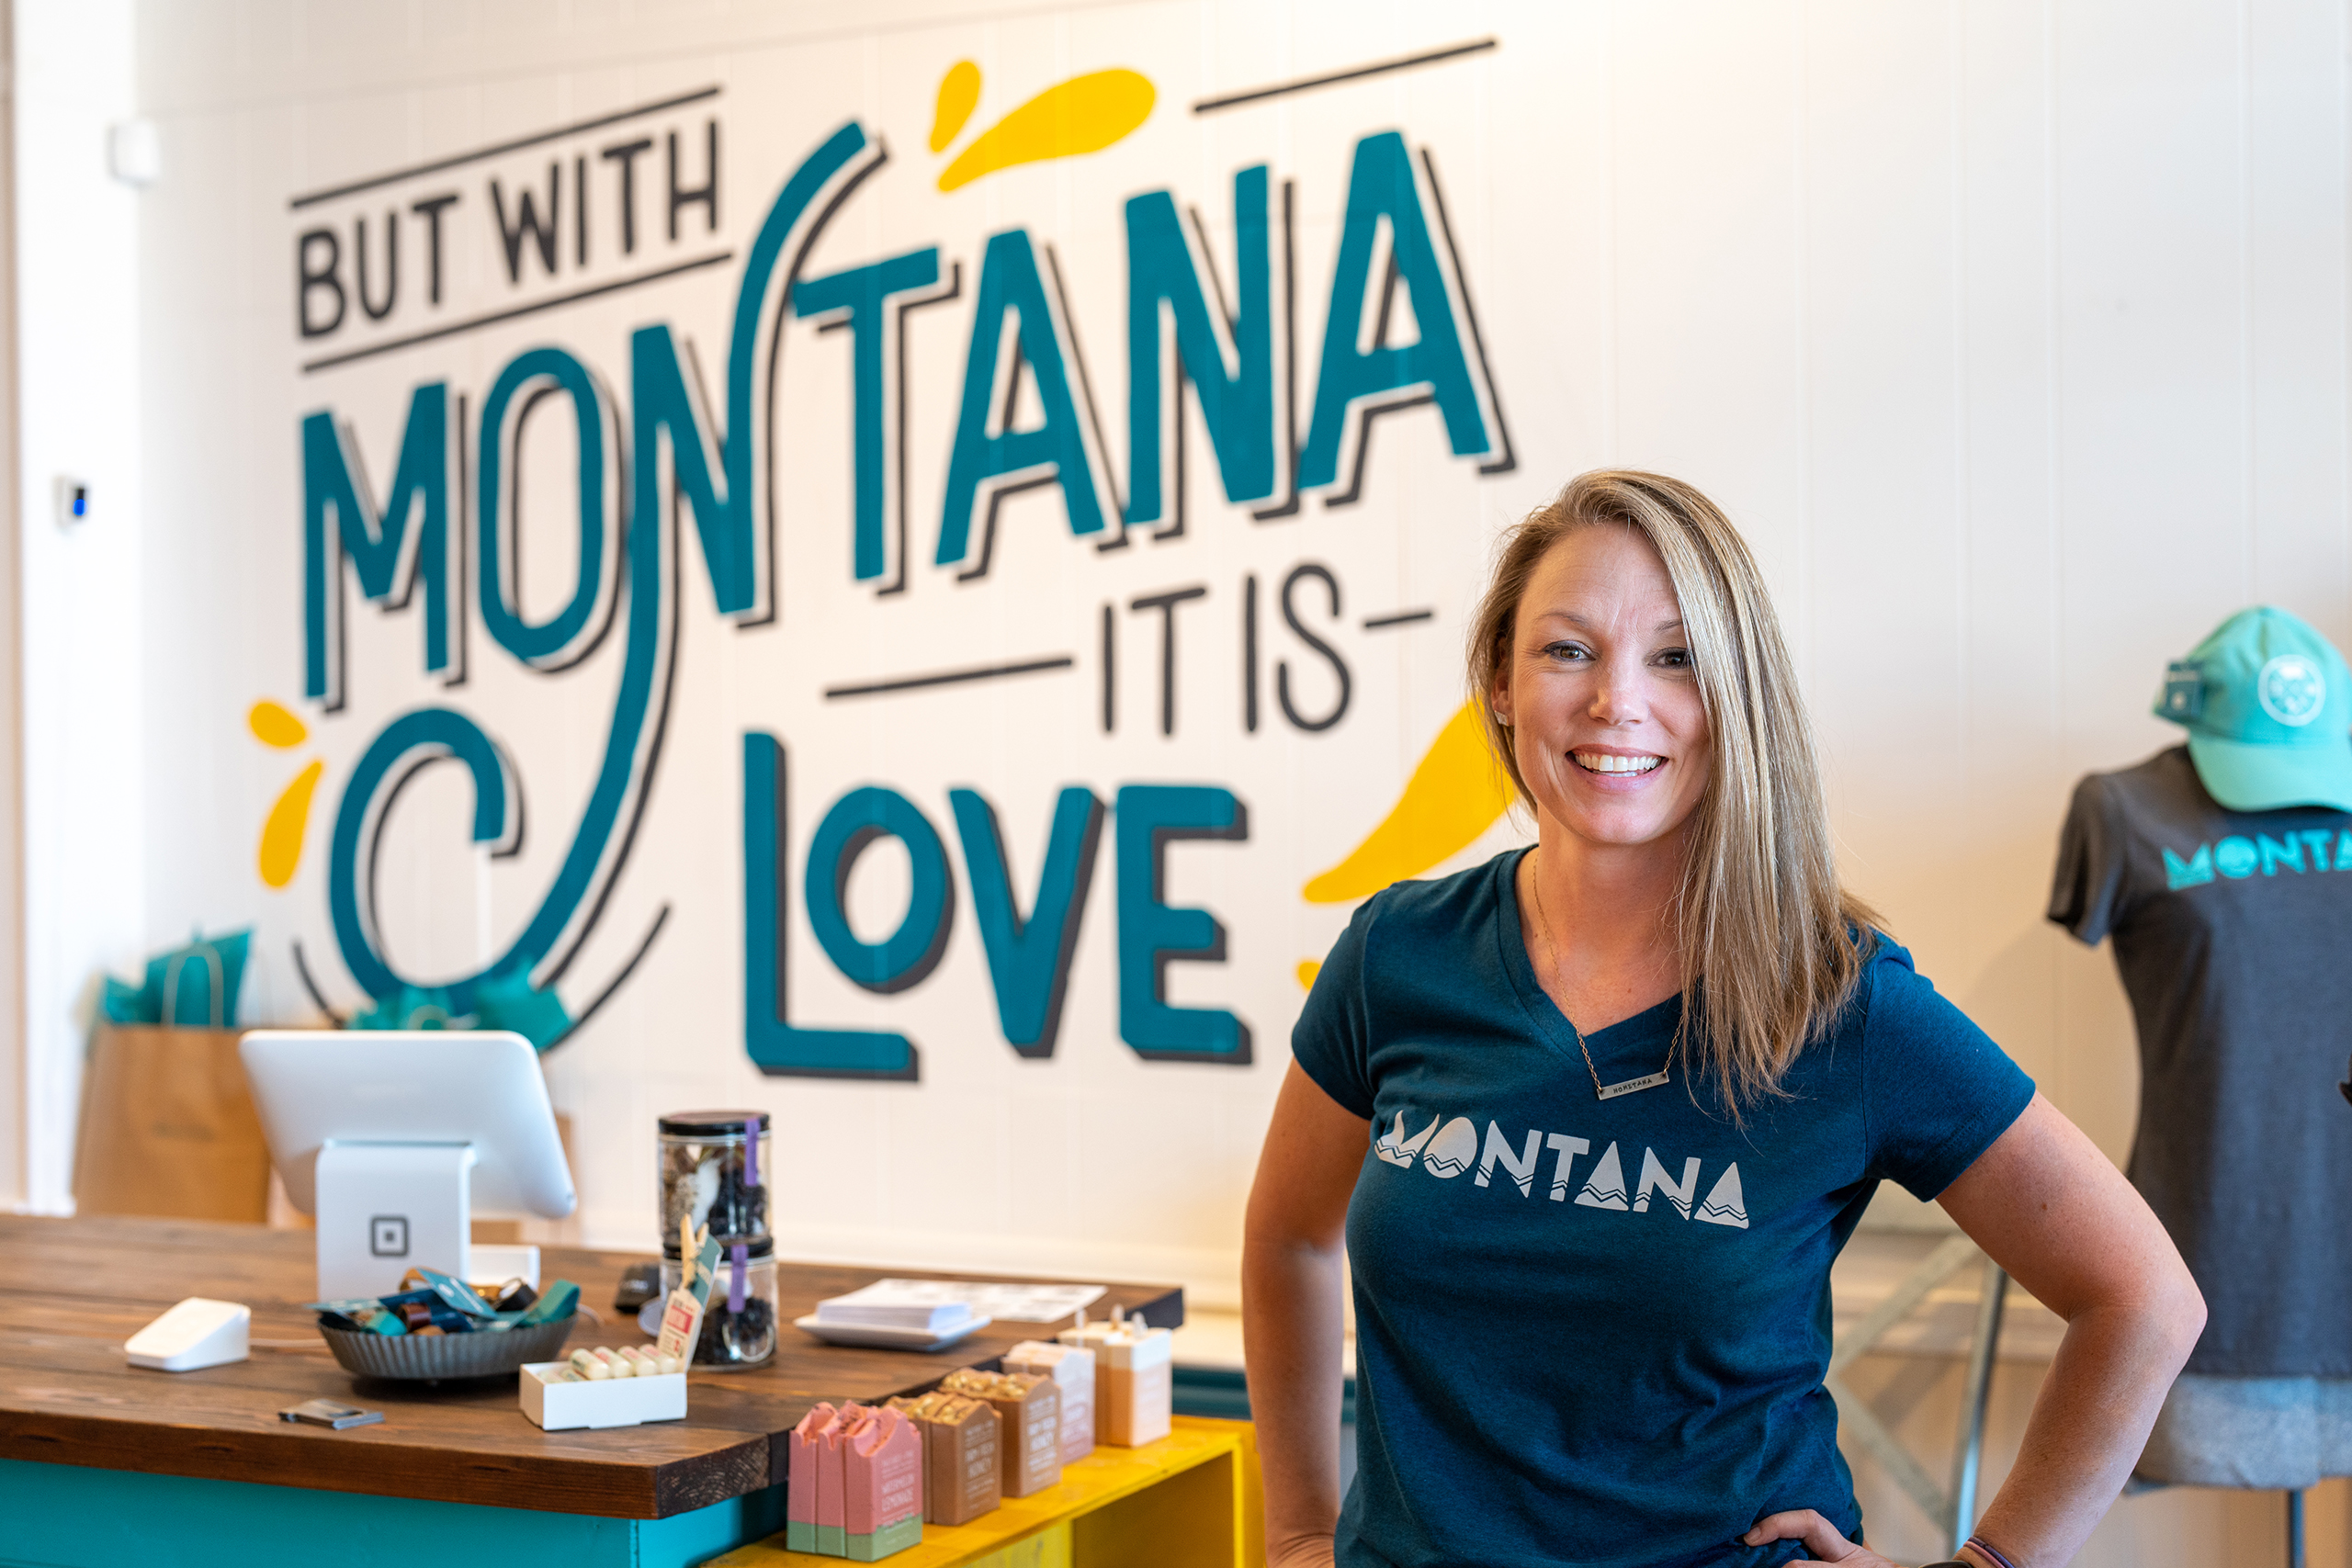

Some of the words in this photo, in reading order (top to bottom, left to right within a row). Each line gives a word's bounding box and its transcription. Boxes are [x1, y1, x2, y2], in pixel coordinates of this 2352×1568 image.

[297, 192, 461, 340] BUT
[488, 117, 720, 285] WITH
[299, 118, 1519, 1024] MONTANA
[1102, 583, 1208, 739] IT
[1244, 561, 1354, 736] IS
[741, 731, 1253, 1084] LOVE
[1374, 1109, 1749, 1229] MONTANA
